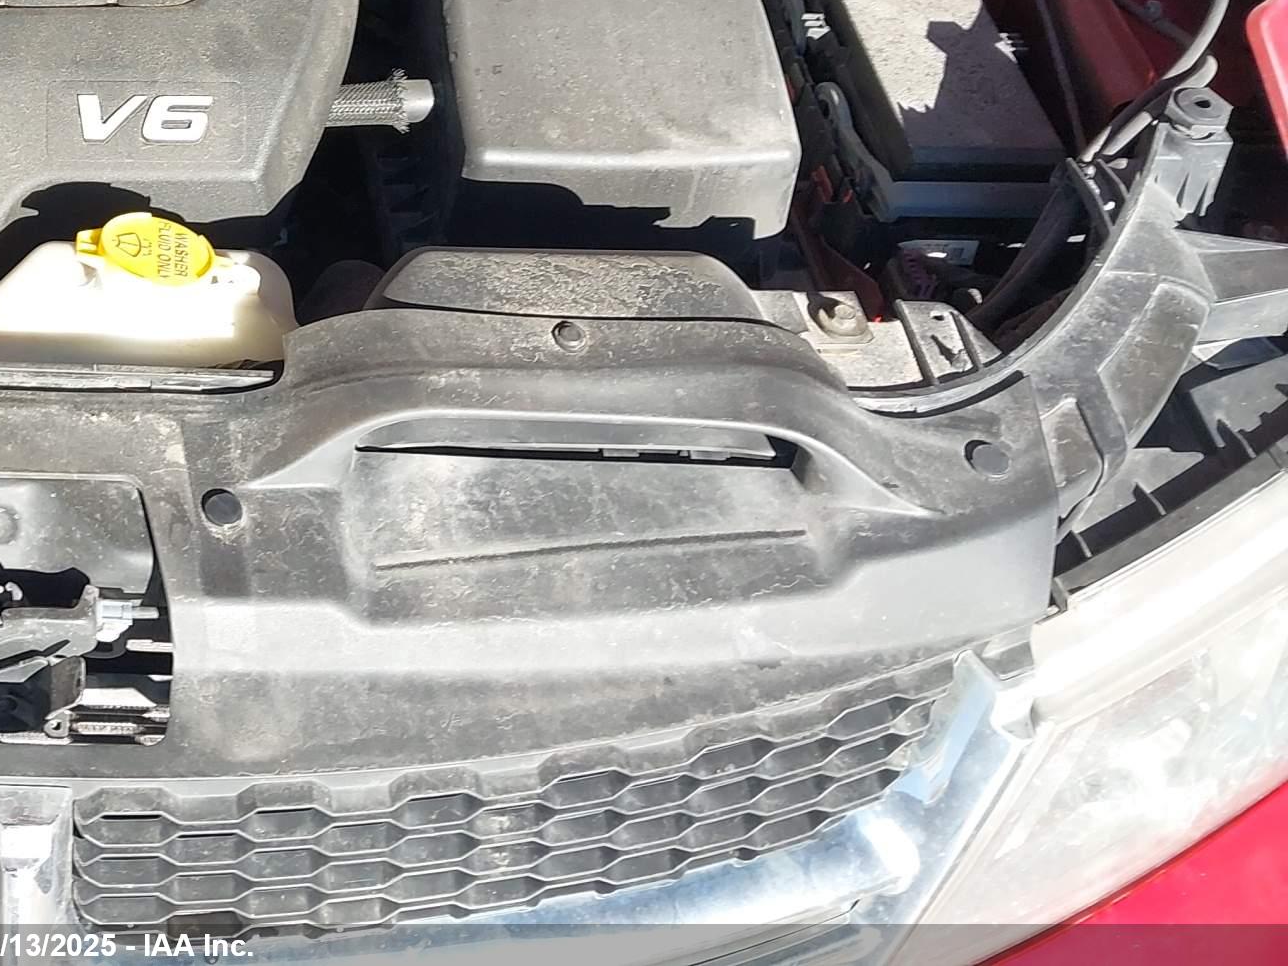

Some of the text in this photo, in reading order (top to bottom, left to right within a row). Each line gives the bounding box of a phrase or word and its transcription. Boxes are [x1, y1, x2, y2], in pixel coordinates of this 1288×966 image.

[77, 93, 214, 144] V6
[158, 221, 172, 251] FLUID
[175, 232, 189, 277] WASHER
